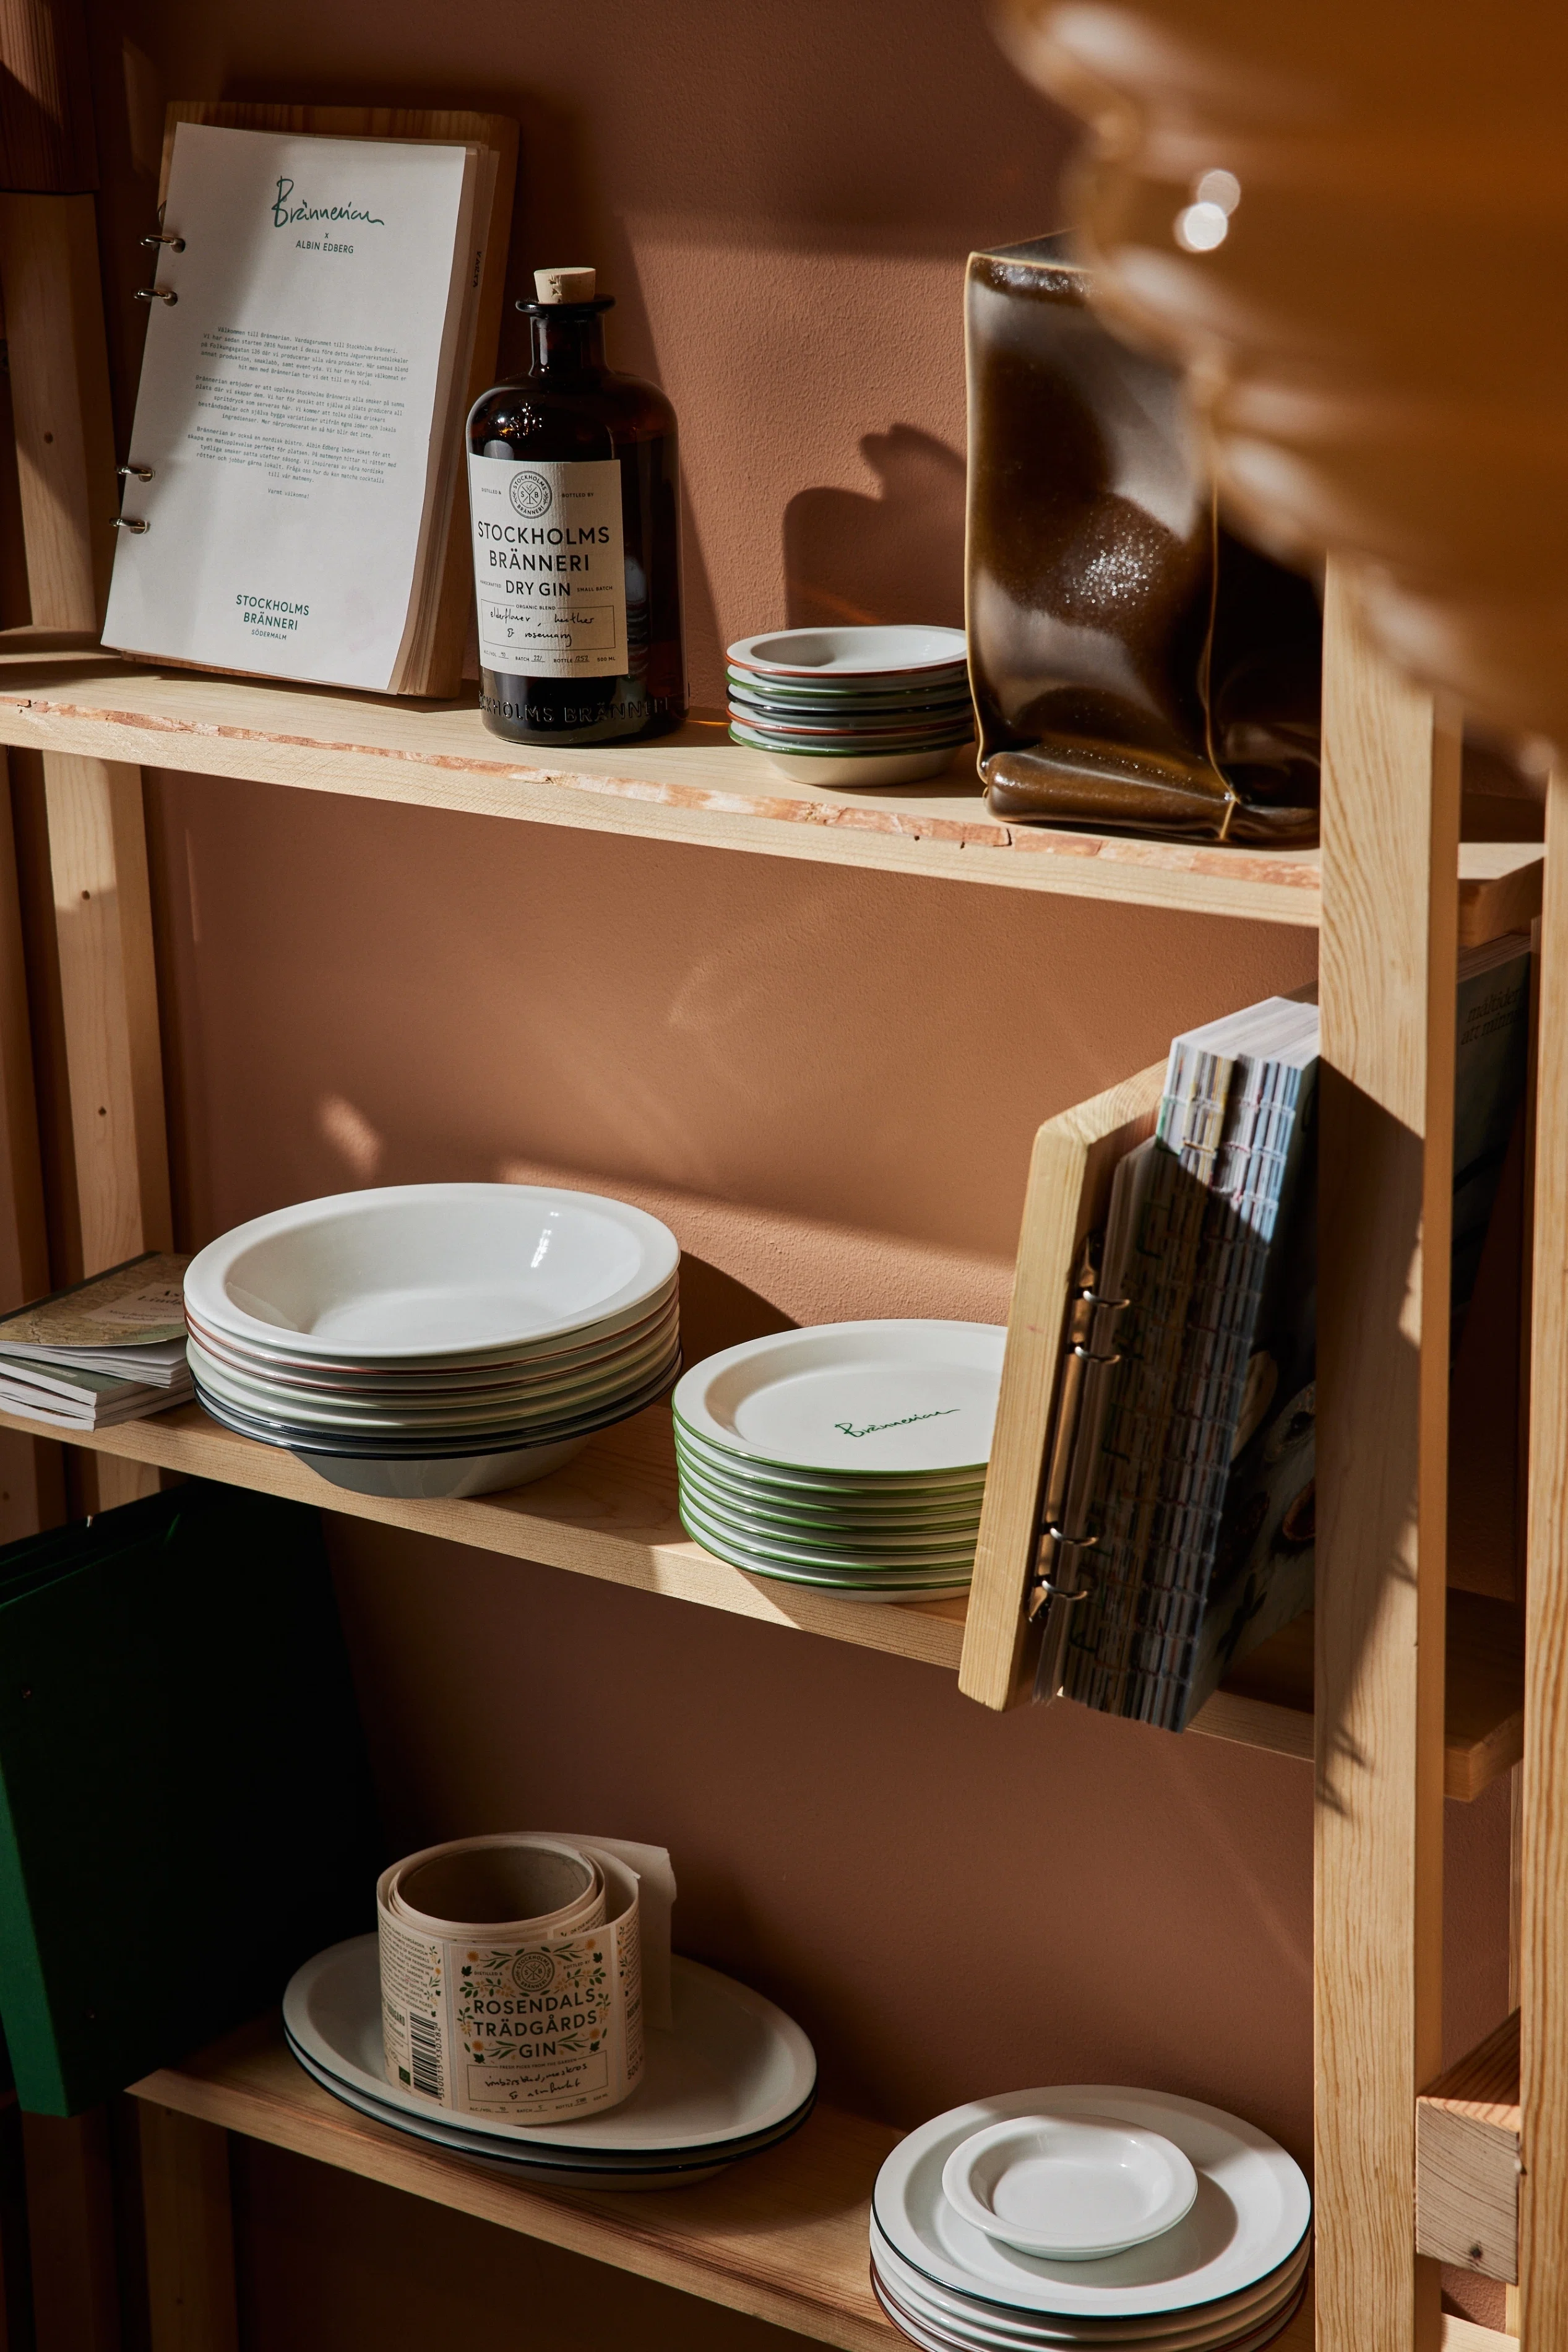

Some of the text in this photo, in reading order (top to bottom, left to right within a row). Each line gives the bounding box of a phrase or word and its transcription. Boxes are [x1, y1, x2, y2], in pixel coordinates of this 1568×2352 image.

[272, 176, 384, 228] Brännerian
[296, 240, 354, 254] ALBIN EDBERG
[210, 342, 249, 353] Folkungagatan
[217, 326, 245, 335] Välkommen
[261, 332, 292, 341] Brännerian.
[295, 337, 331, 346] Vardagsrummet
[346, 342, 373, 350] Stockholms
[374, 345, 397, 353] Bränneri.
[278, 342, 298, 350] huserat
[350, 352, 408, 365] Jaguarverkstadslokaler
[196, 374, 226, 384] Brännerian
[296, 389, 324, 397] Stockholms
[326, 392, 351, 400] Bränneris
[199, 400, 238, 411] beståndsdelar
[270, 411, 286, 419] bygga
[287, 414, 318, 422] variationer
[197, 426, 227, 435] Brännerian
[322, 444, 339, 452] Edberg
[513, 475, 547, 491] STOCKHOLMS
[284, 490, 310, 498] välkomna!
[517, 504, 545, 515] BRÄNNERI
[478, 521, 610, 545] STOCKHOLMS
[489, 548, 589, 571] BRÄNNERI
[480, 580, 502, 588] HANDCRAFTED
[506, 580, 534, 595] DRY
[539, 582, 571, 596] GIN
[236, 594, 309, 616] STOCKHOLMS
[243, 612, 298, 630] BRÄNNERI
[251, 629, 286, 640] SÖDERMALM
[525, 632, 572, 647] rosemary
[834, 1409, 961, 1438] Brännerian
[516, 1955, 550, 1969] STOCKHOLMS
[563, 1961, 584, 1969] BOTTLED
[520, 1979, 548, 1989] BRÄNNERI
[474, 1988, 595, 2015] ROSENDALS
[473, 2010, 597, 2037] TRÄDGÅRDS
[519, 2040, 557, 2059] GIN
